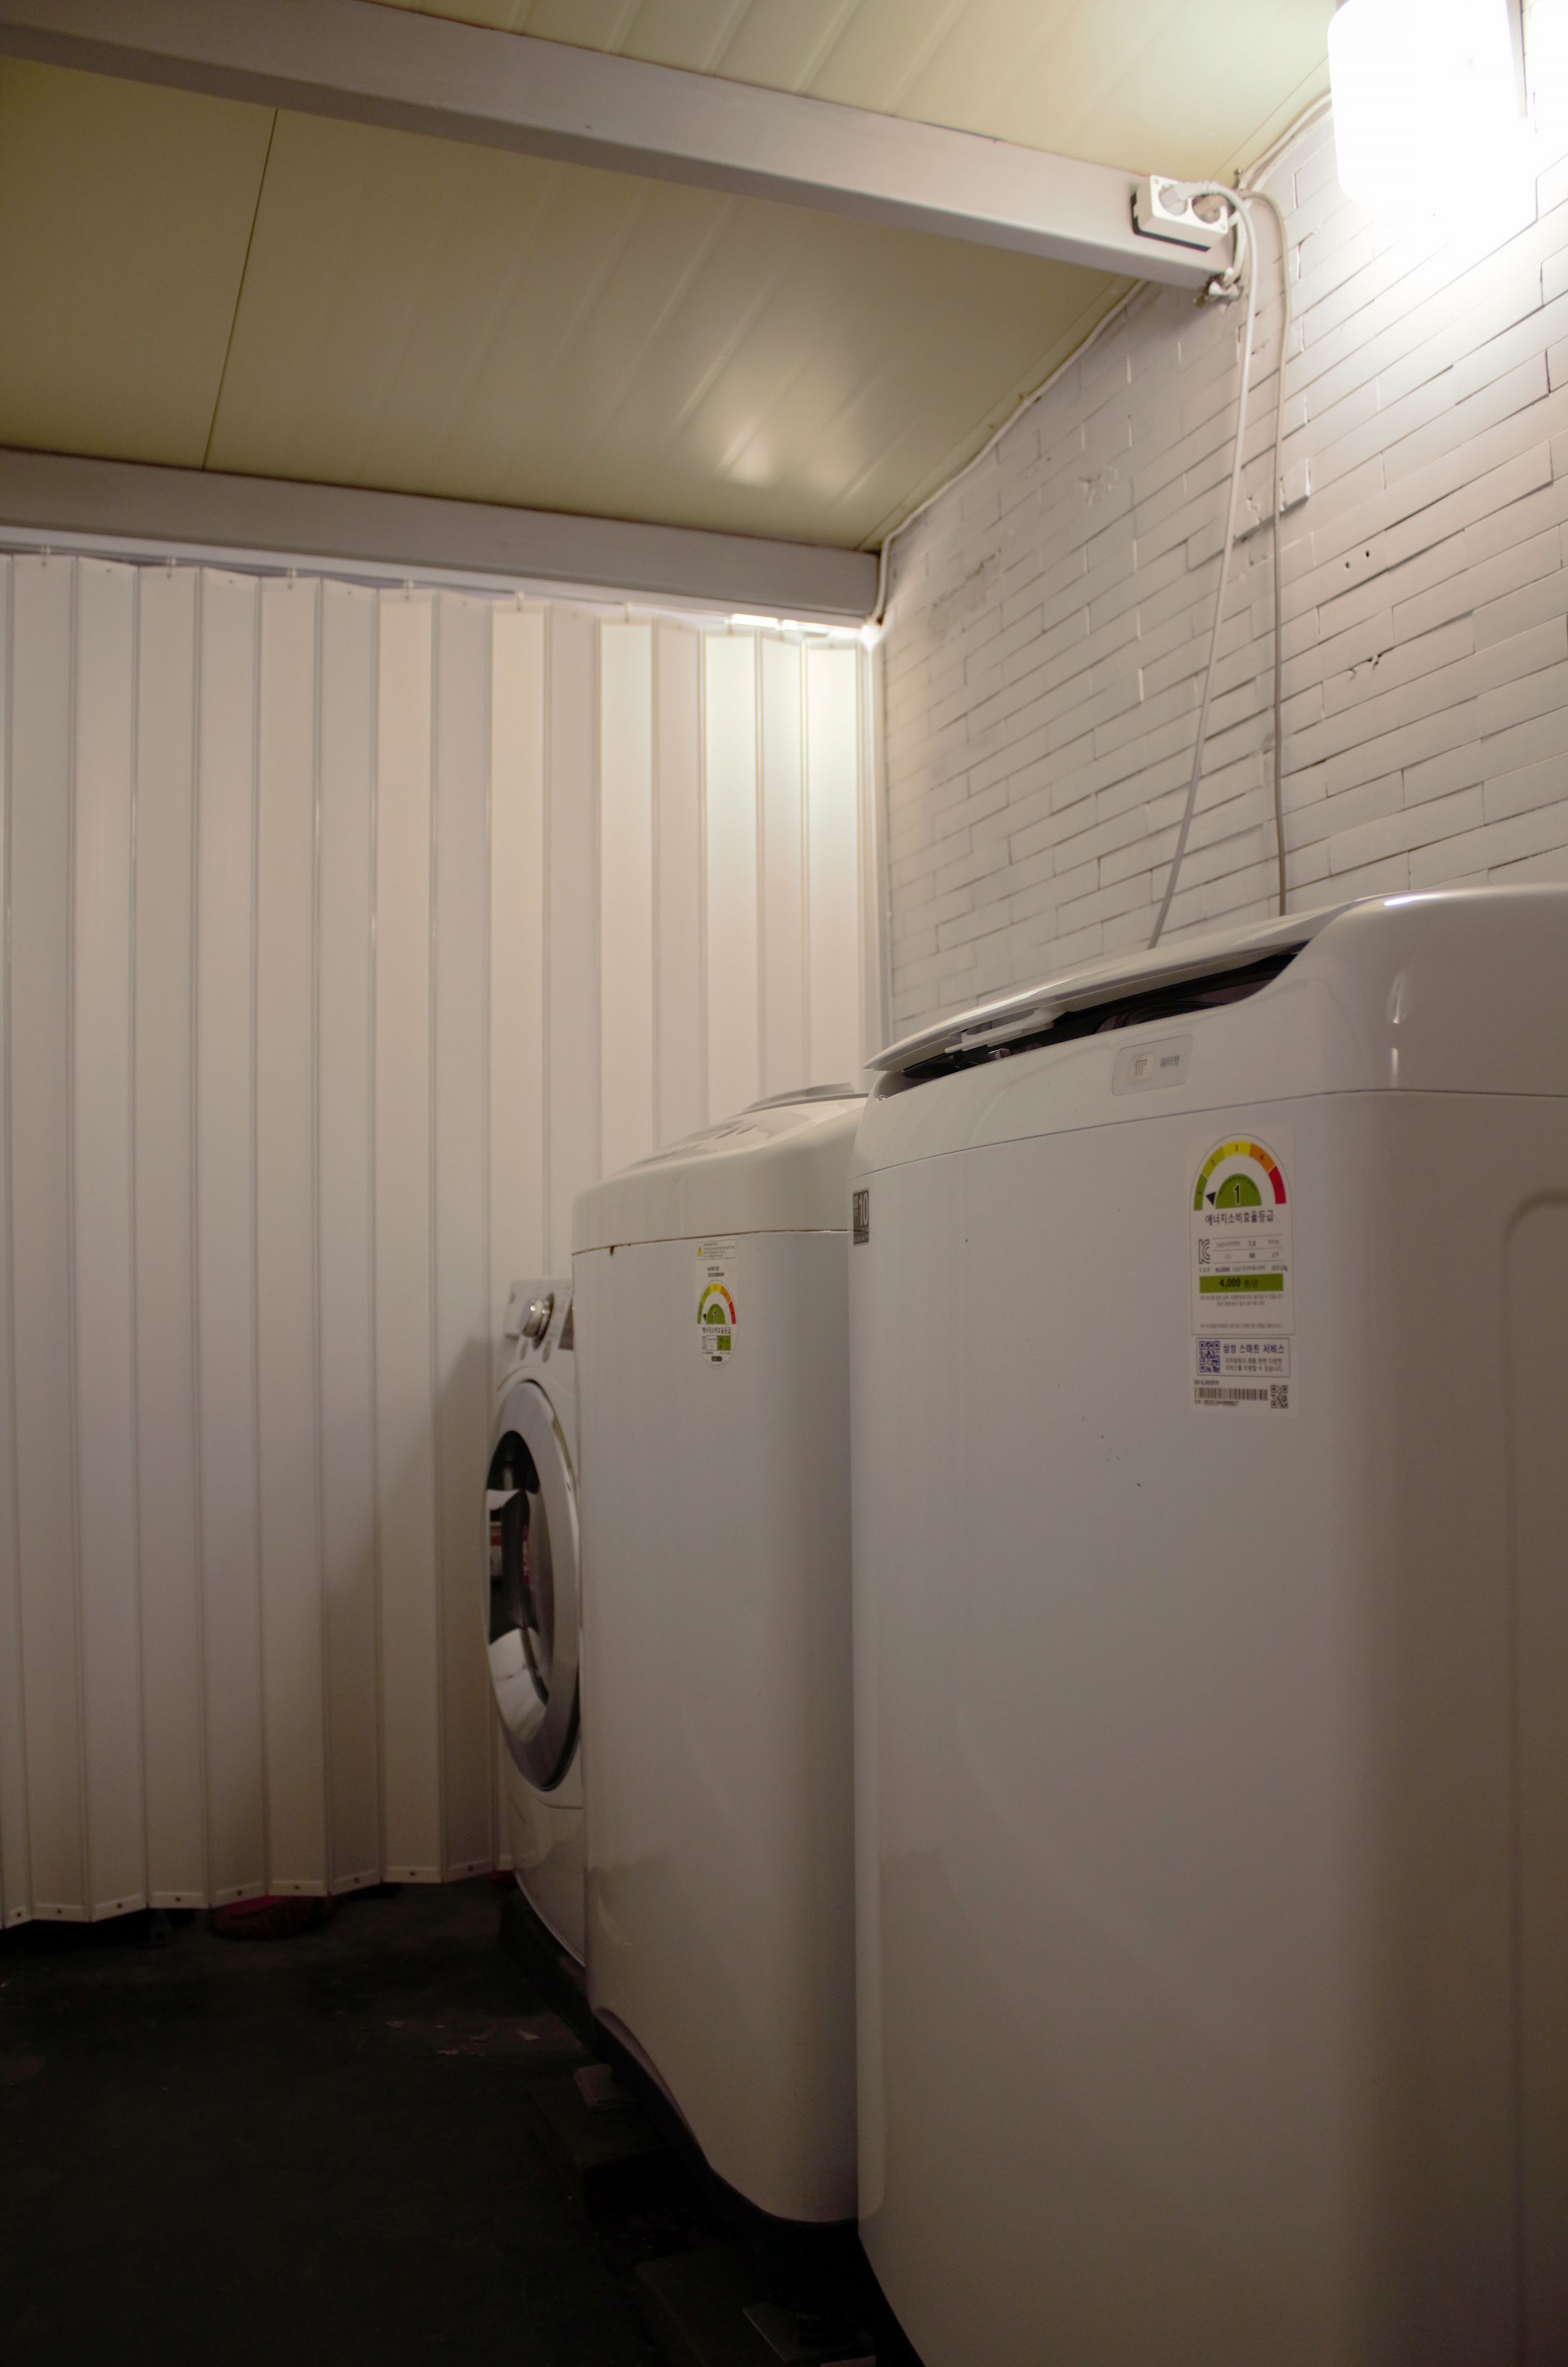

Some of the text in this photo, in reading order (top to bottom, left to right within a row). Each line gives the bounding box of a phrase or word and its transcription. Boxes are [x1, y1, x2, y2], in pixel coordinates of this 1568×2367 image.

[1234, 1184, 1240, 1206] 1
[859, 1193, 868, 1225] 10
[1205, 1210, 1273, 1225] 에너지소비효율등급
[1223, 1344, 1284, 1354] 삼성 스마트 서비스
